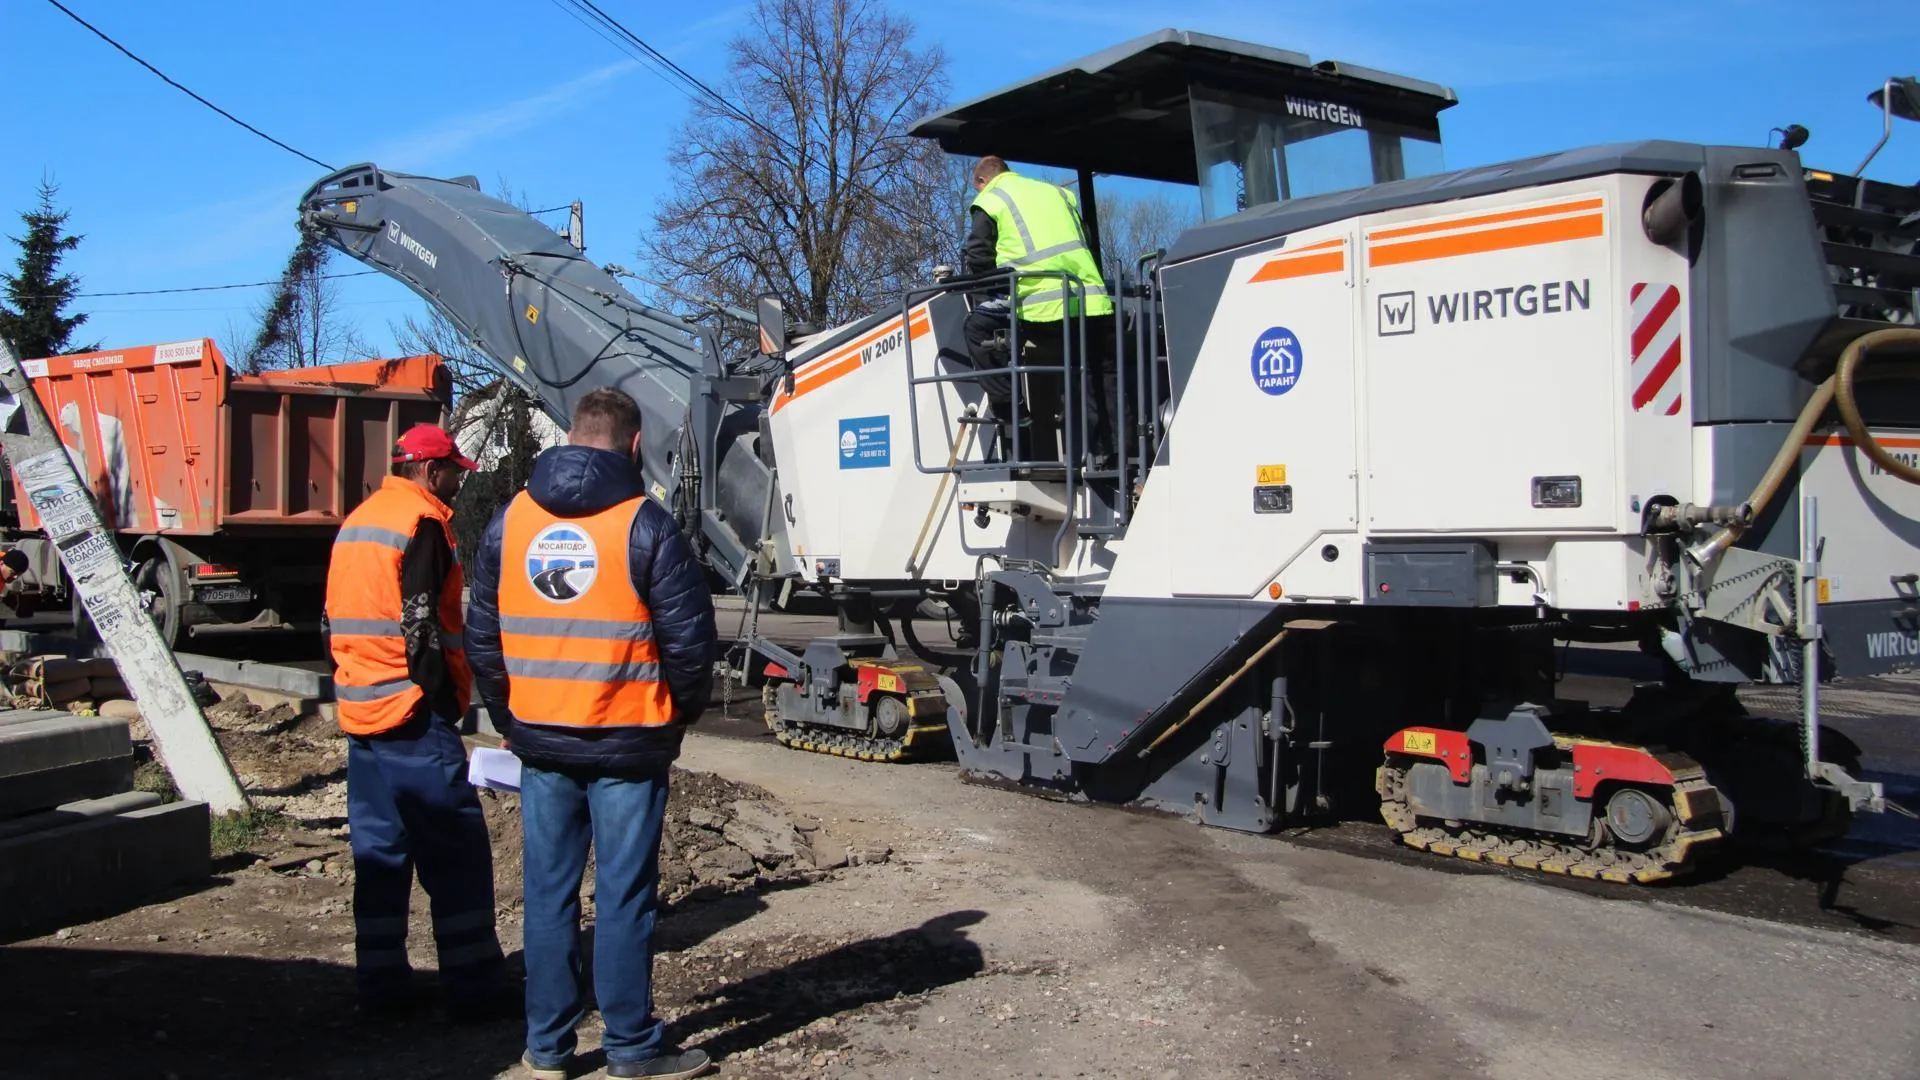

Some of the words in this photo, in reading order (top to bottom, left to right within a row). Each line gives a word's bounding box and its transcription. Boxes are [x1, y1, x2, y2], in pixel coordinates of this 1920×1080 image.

[1284, 95, 1362, 127] WIRTGEN
[400, 231, 438, 269] WIRTGEN
[1427, 278, 1590, 325] WIRTGEN
[862, 346, 873, 365] W
[875, 334, 896, 359] 200
[897, 330, 903, 348] F
[1261, 337, 1292, 350] ГРУППА
[1259, 375, 1295, 388] ГАРАНТ
[51, 527, 59, 536] 8
[59, 520, 75, 533] 937
[538, 543, 588, 551] МОСАВТОДОР
[1866, 632, 1920, 659] WIRTG
